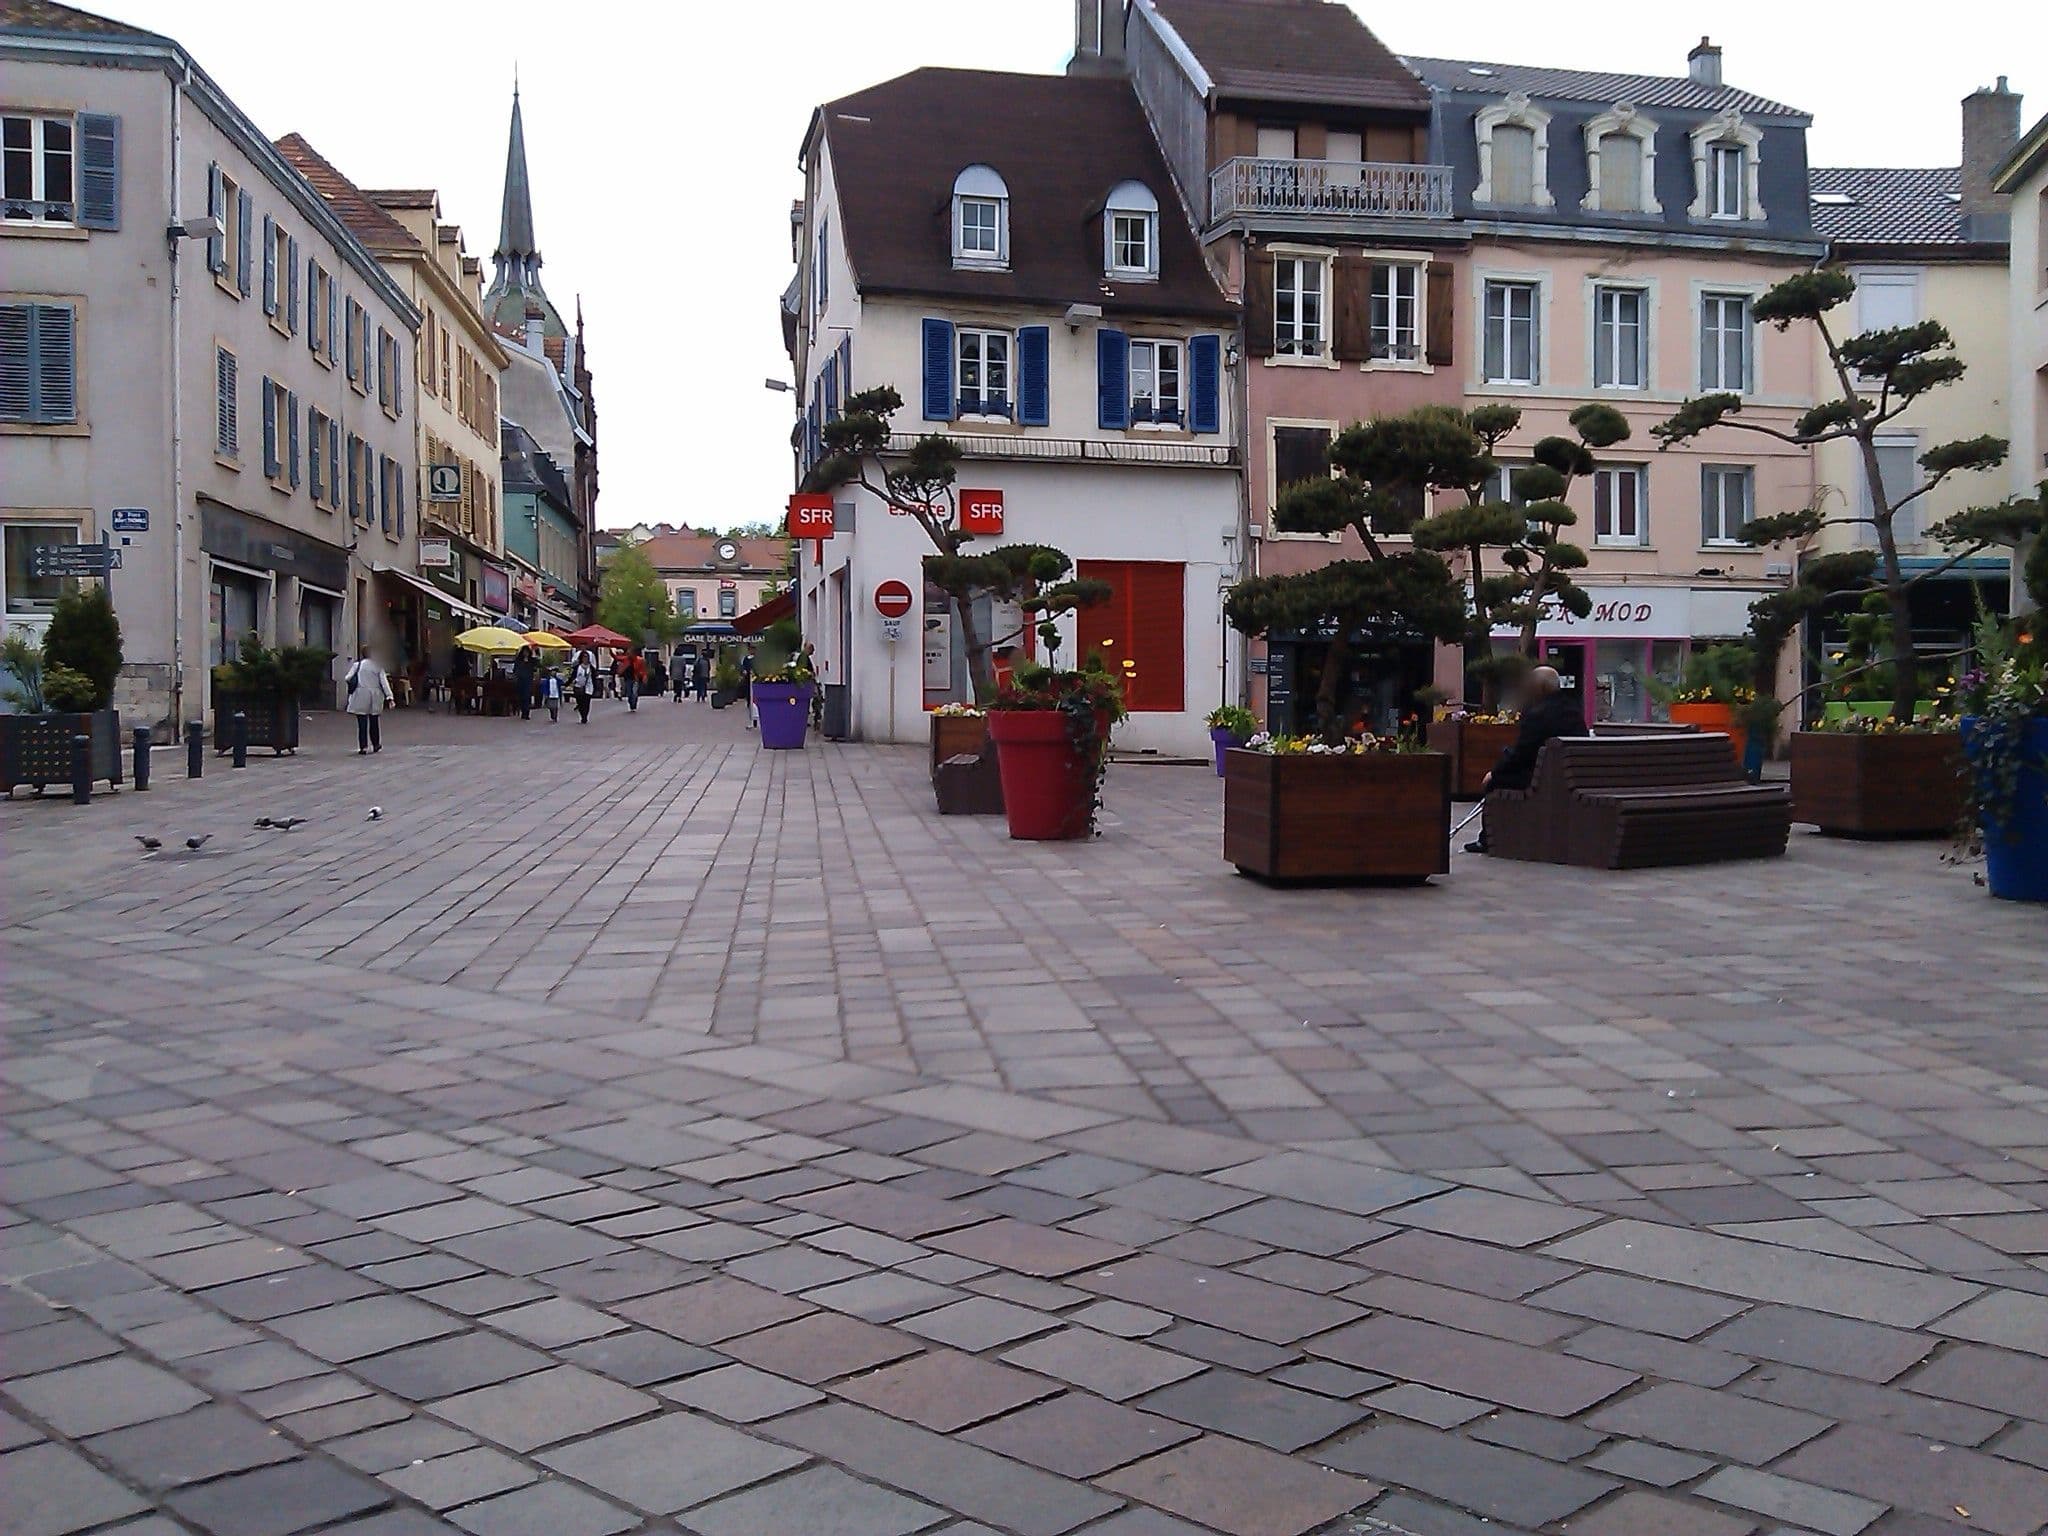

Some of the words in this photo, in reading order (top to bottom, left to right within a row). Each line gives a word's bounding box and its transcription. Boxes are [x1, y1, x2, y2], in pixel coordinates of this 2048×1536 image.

[800, 508, 833, 524] SFR
[970, 503, 1003, 519] SFR
[1595, 601, 1652, 622] MOD
[684, 635, 705, 643] GARE
[707, 635, 718, 643] DE
